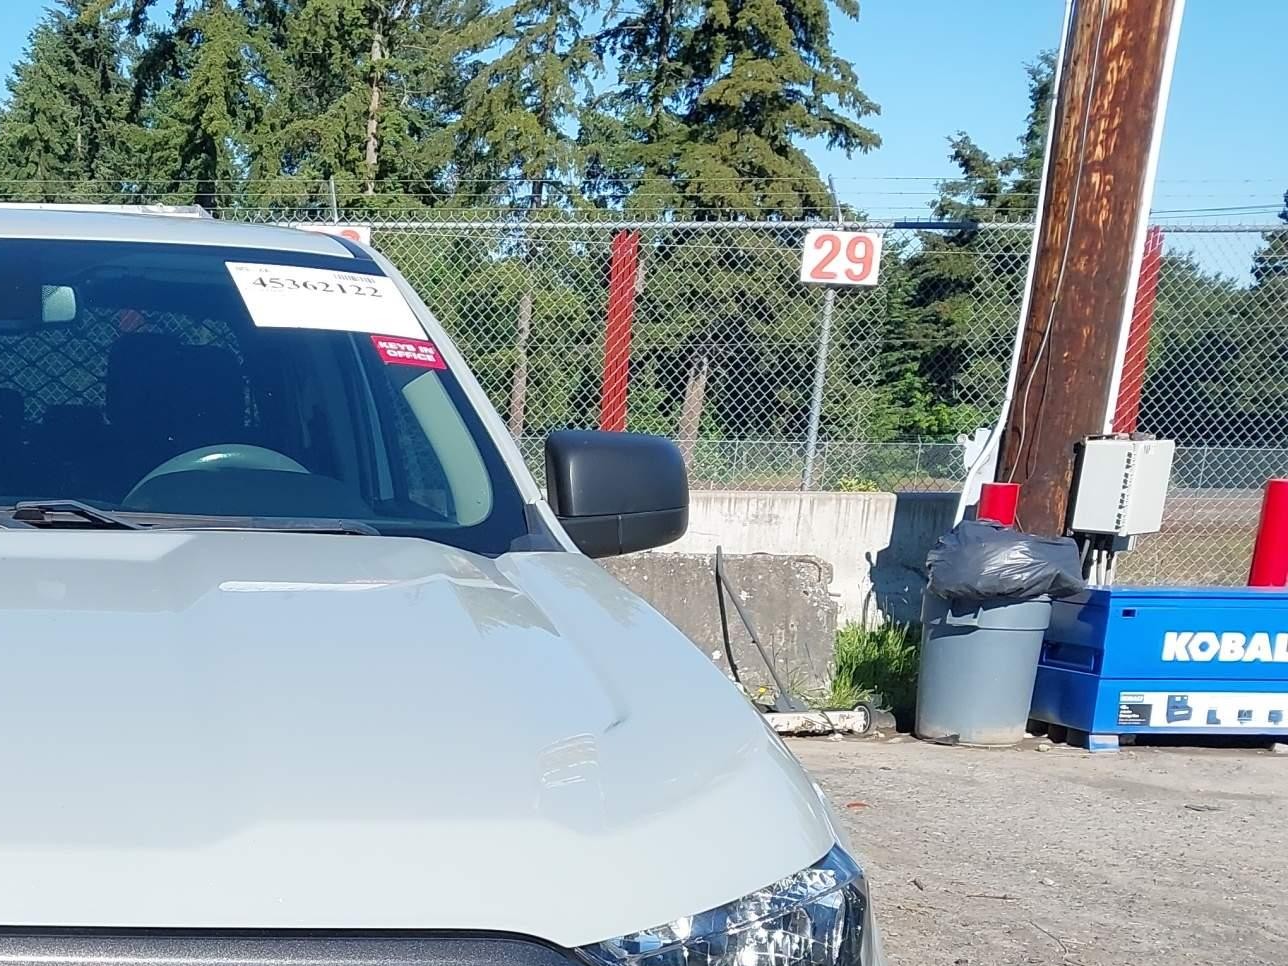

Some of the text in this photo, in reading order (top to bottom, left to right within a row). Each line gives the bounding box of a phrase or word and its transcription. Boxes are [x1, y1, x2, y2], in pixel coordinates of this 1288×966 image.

[811, 234, 874, 282] 29
[252, 276, 383, 298] 45362122
[378, 341, 435, 354] KEYS IN
[387, 350, 436, 362] OFFICE
